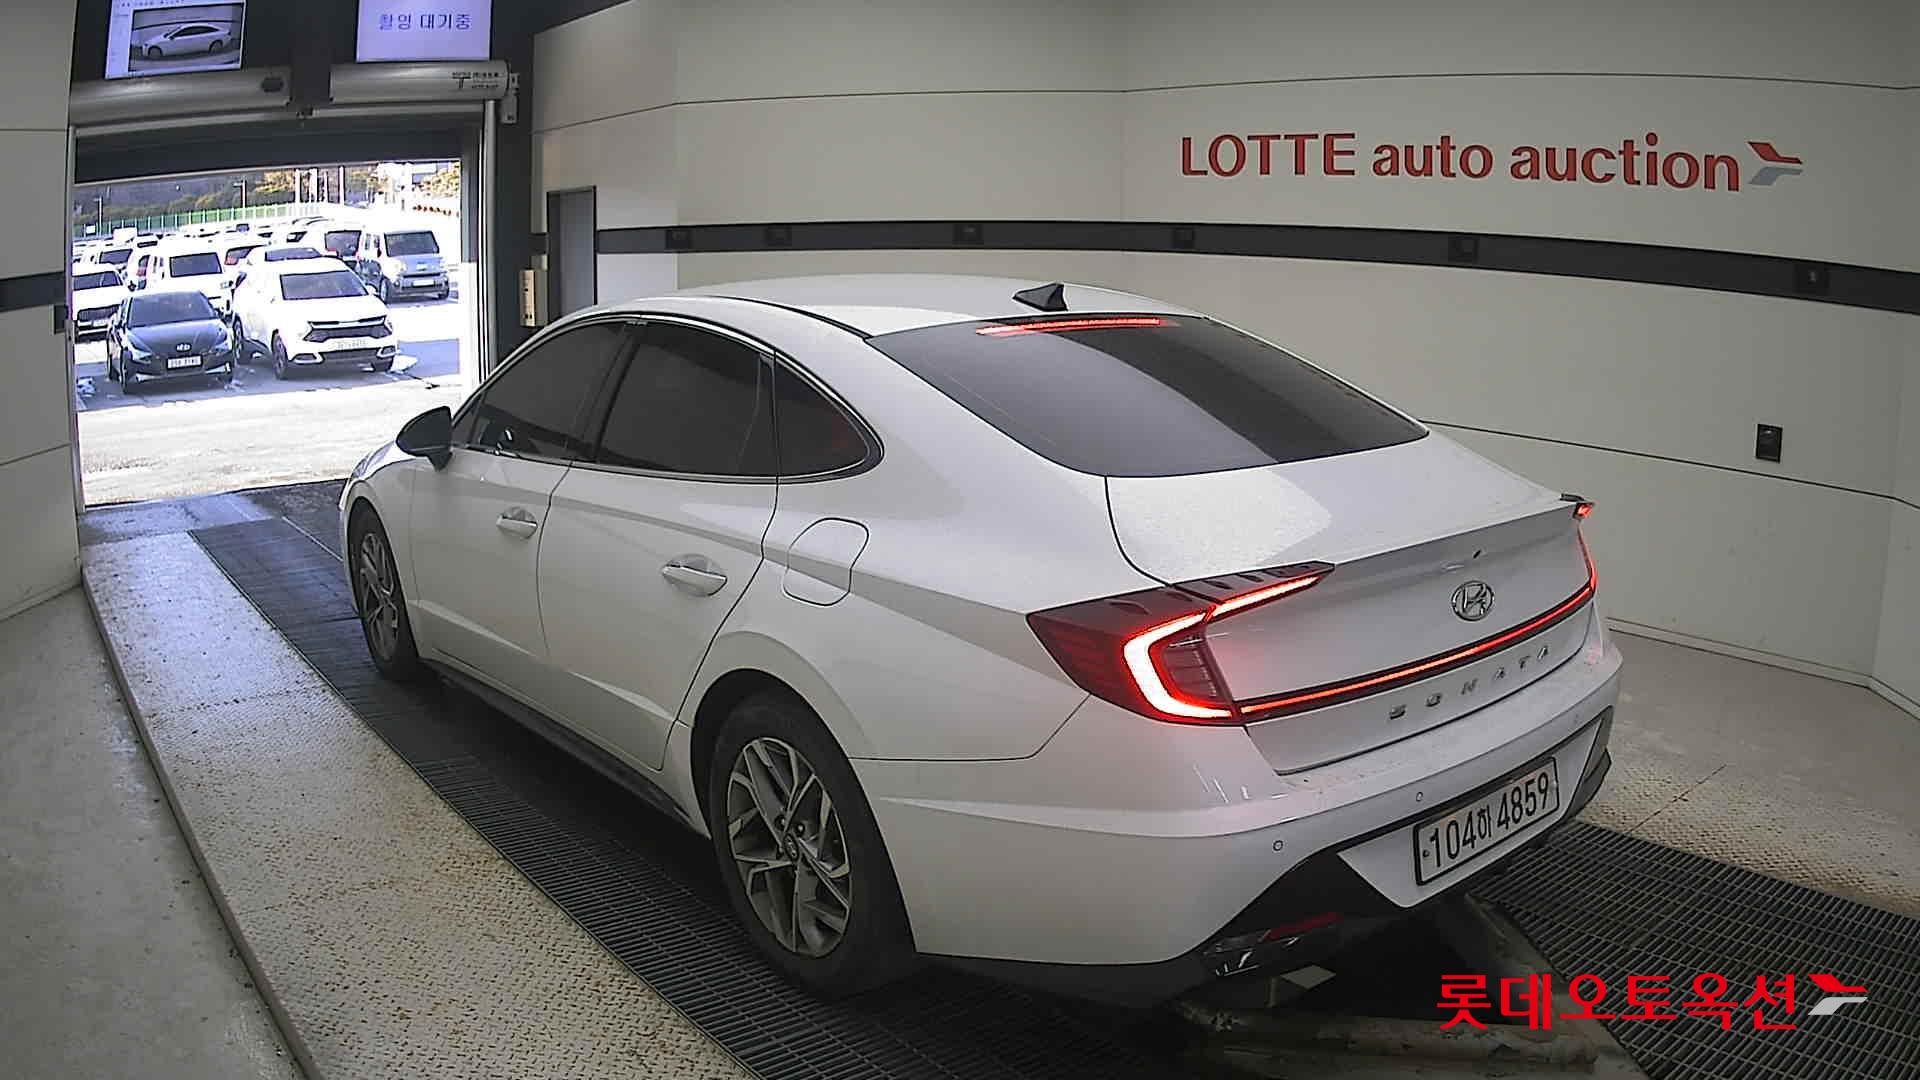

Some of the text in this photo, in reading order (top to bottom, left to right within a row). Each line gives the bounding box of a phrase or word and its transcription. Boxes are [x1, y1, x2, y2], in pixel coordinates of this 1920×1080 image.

[419, 13, 472, 31] 대기중
[1181, 132, 1741, 192] LOTTE auto auction
[1388, 645, 1549, 721] SONATA
